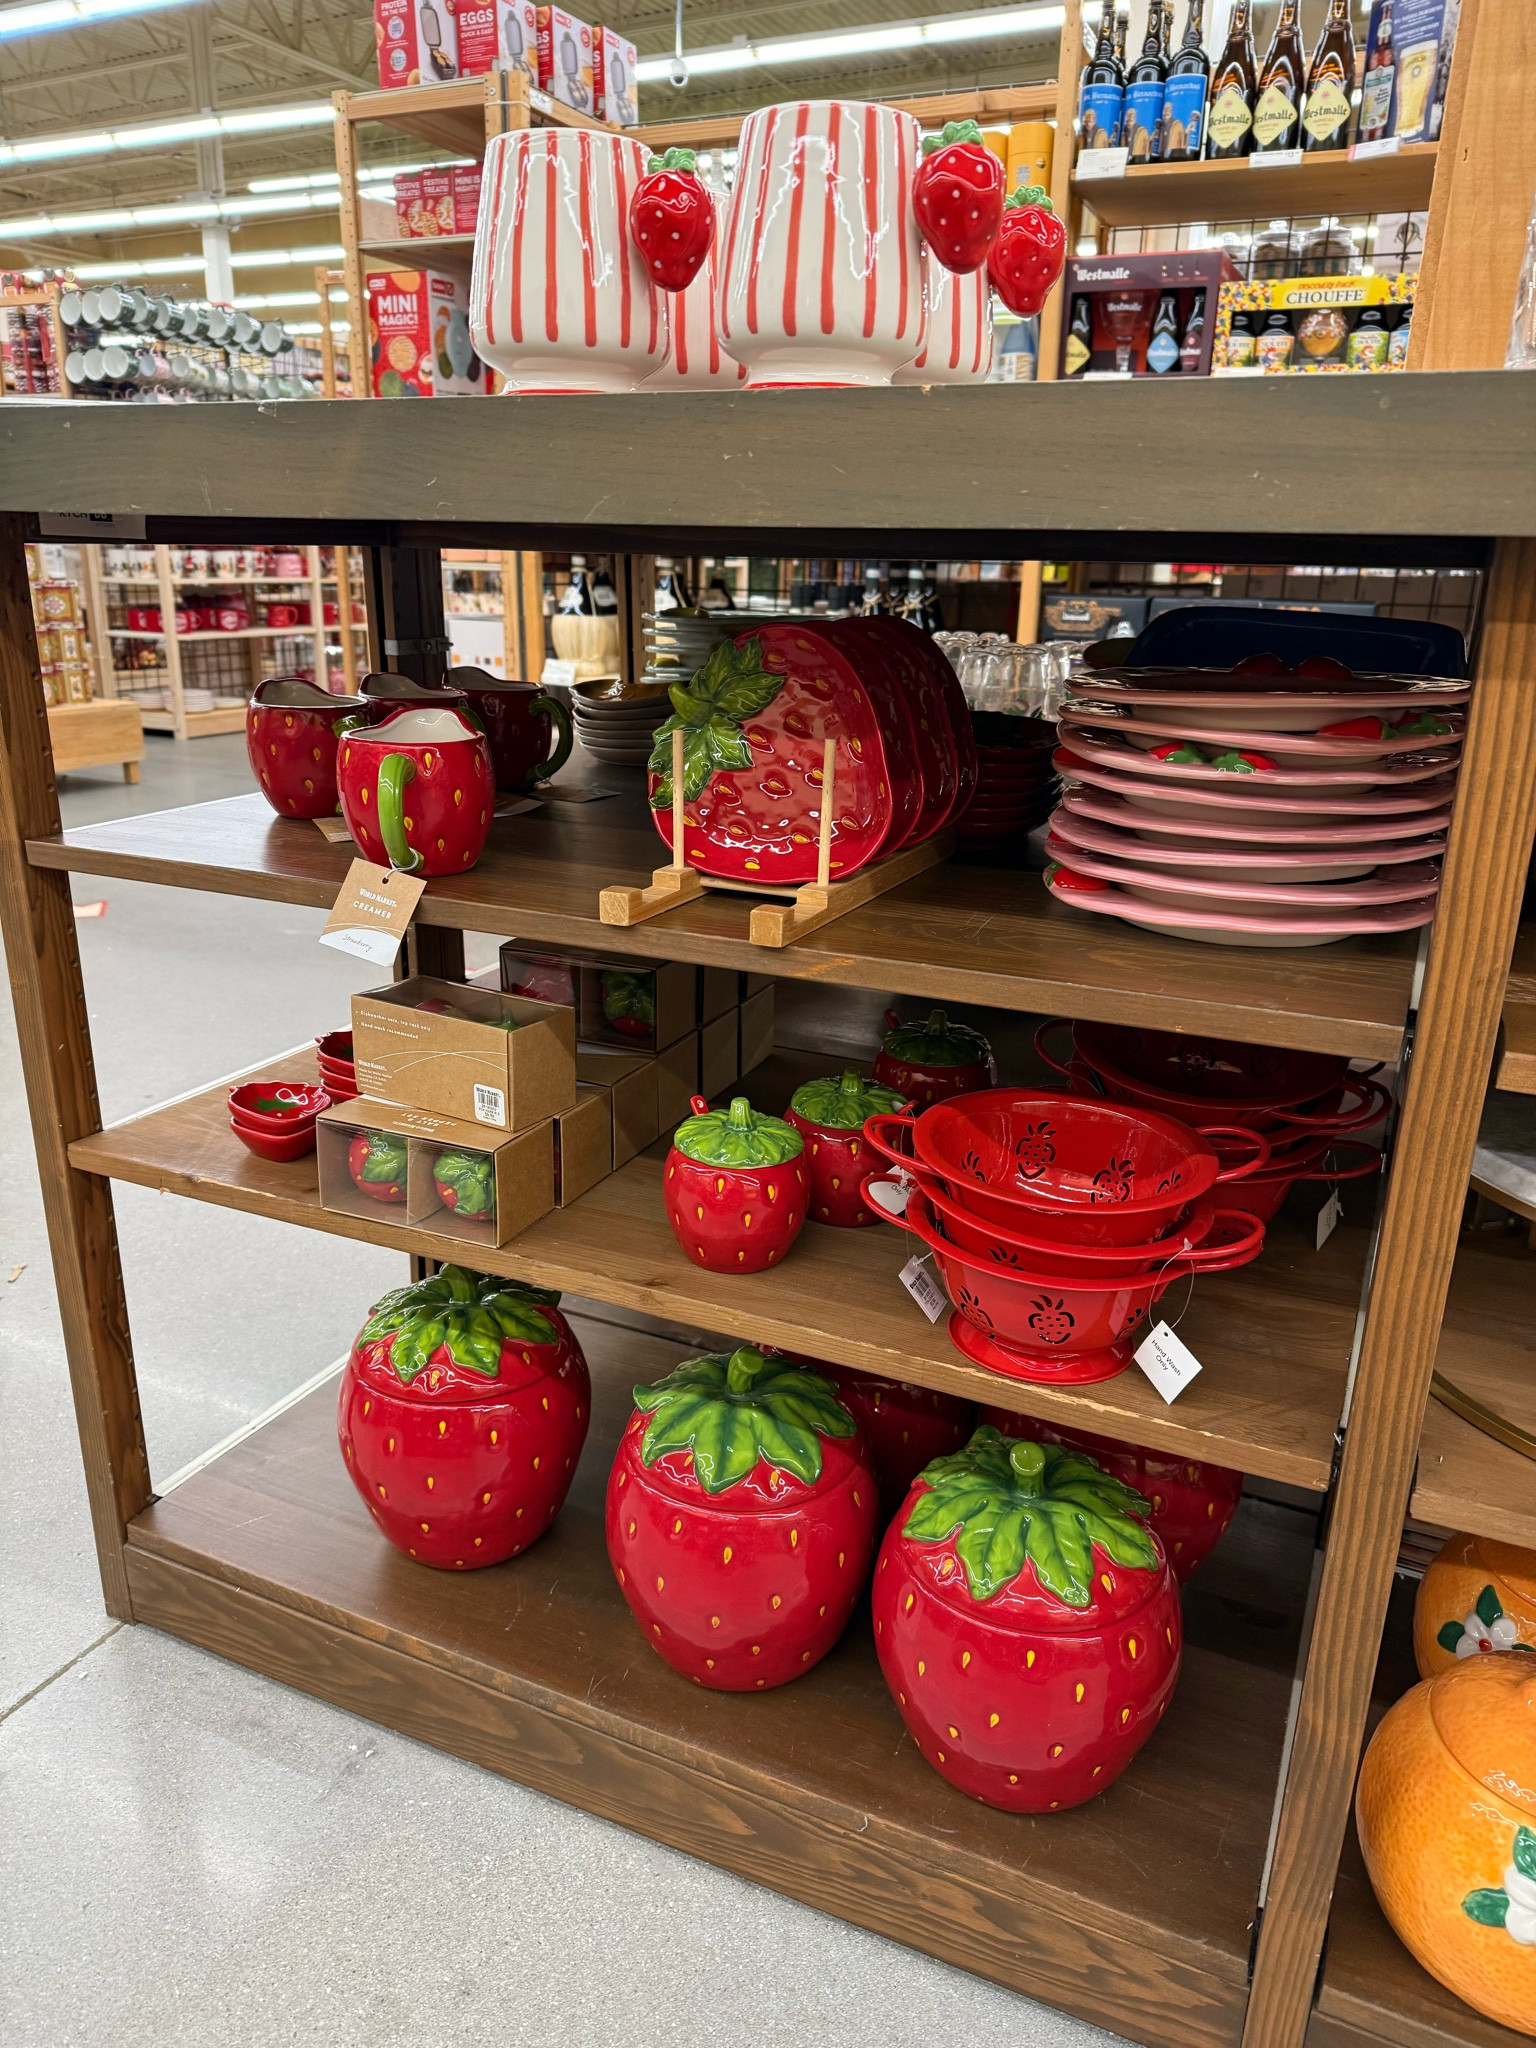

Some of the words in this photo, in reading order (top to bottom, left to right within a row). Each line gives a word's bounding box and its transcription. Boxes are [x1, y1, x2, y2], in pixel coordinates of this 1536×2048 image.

[460, 8, 494, 26] EGGS
[1077, 267, 1130, 281] Westmalle
[377, 294, 417, 313] MINI
[1286, 289, 1364, 304] CHOUFFE
[379, 313, 418, 326] MAGIC!
[353, 900, 392, 919] CREAMER
[1151, 1339, 1167, 1358] Hand
[1166, 1356, 1181, 1376] Wash
[1155, 1354, 1169, 1371] Only
